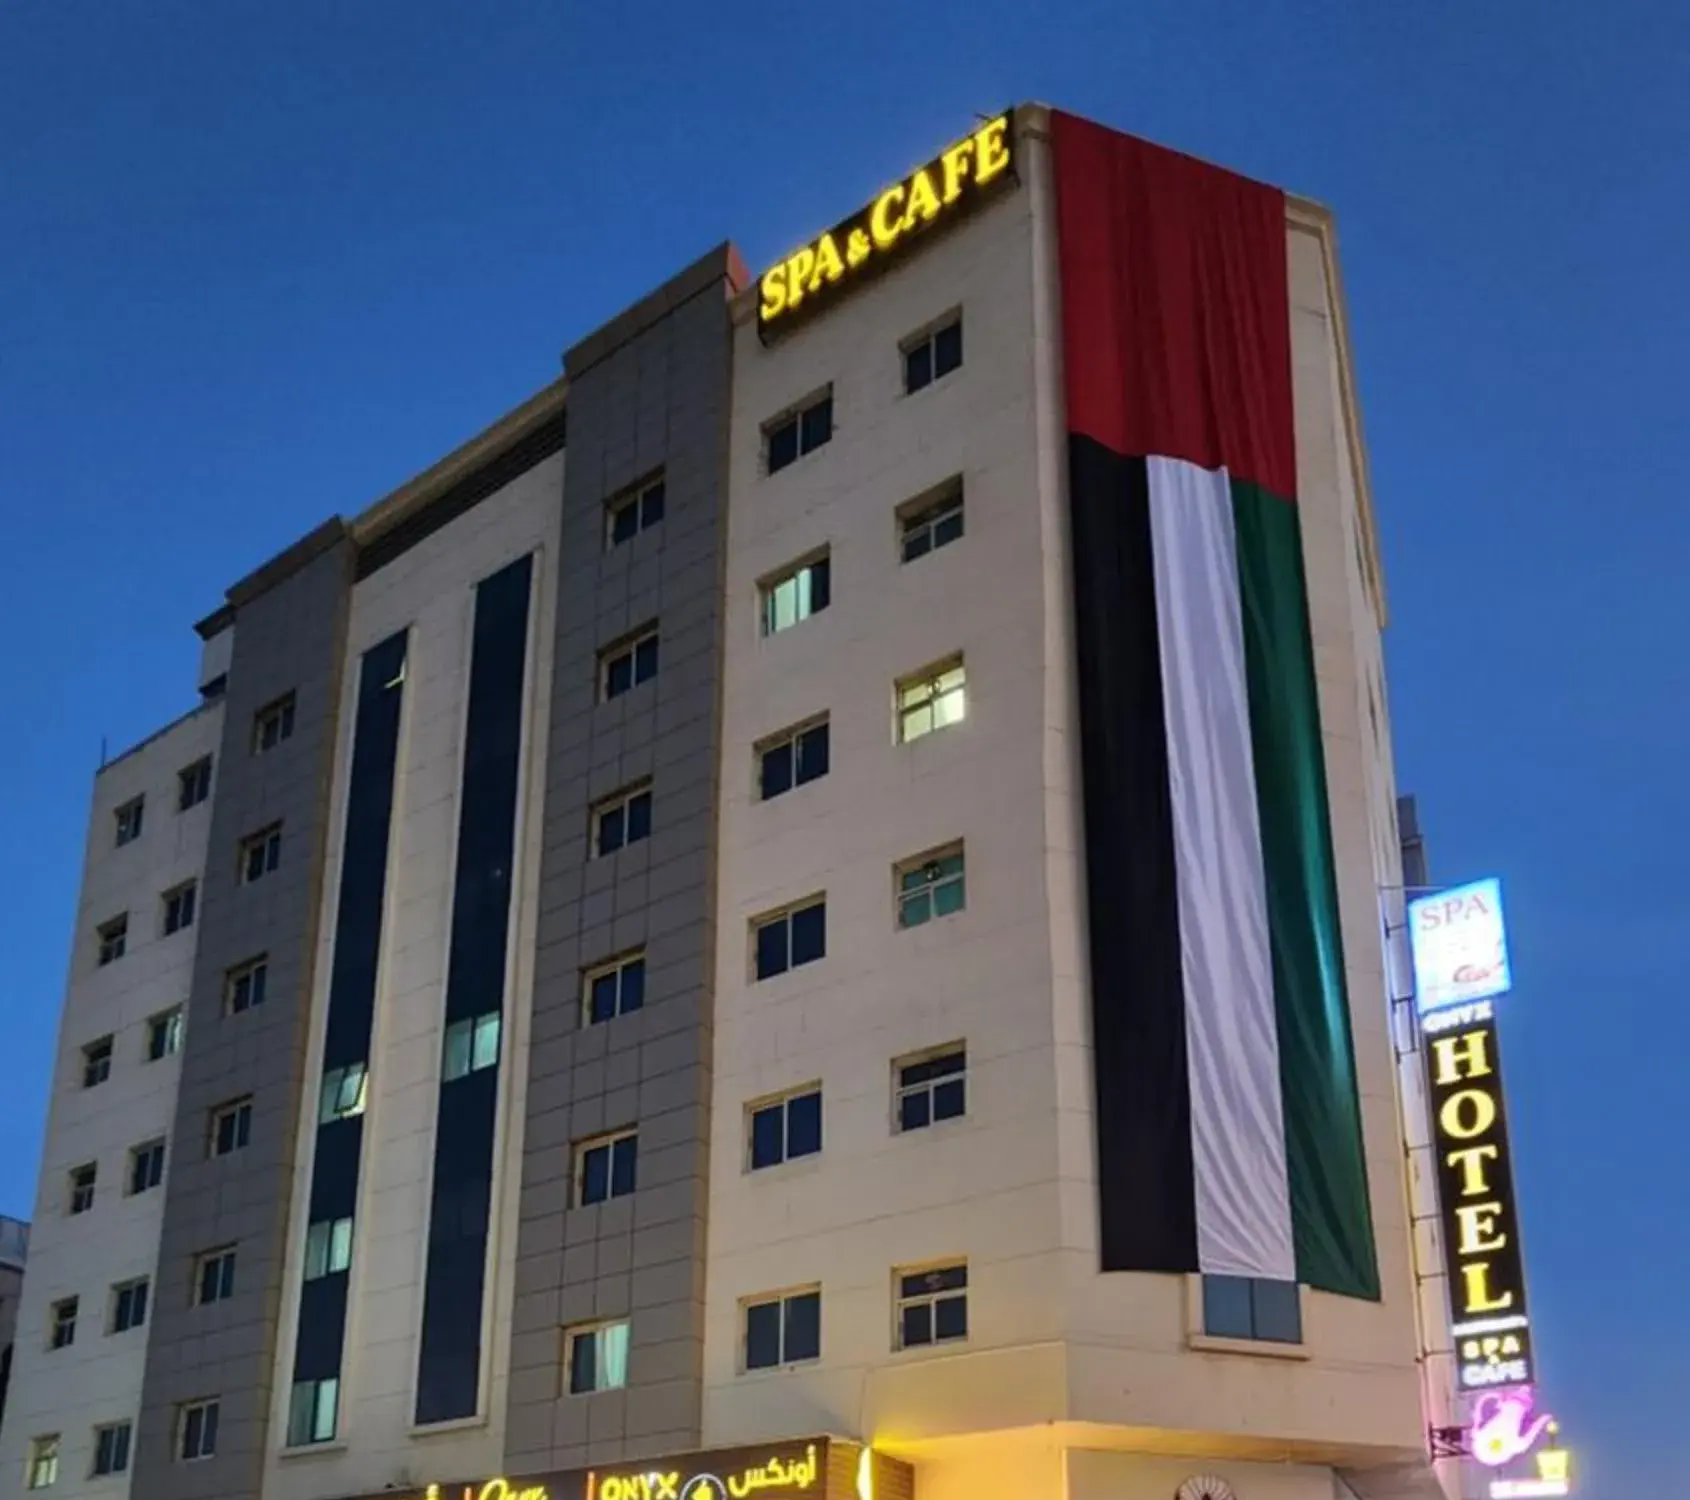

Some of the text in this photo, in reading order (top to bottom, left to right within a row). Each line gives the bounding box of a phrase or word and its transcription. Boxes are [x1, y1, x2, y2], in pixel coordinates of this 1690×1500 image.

[760, 115, 1010, 321] SPA & CAFE
[1420, 893, 1490, 932] SPA
[1432, 1029, 1512, 1313] HOTEL
[1462, 1335, 1520, 1360] SPA
[1462, 1359, 1528, 1387] CAFE
[726, 1443, 817, 1498] أونكس
